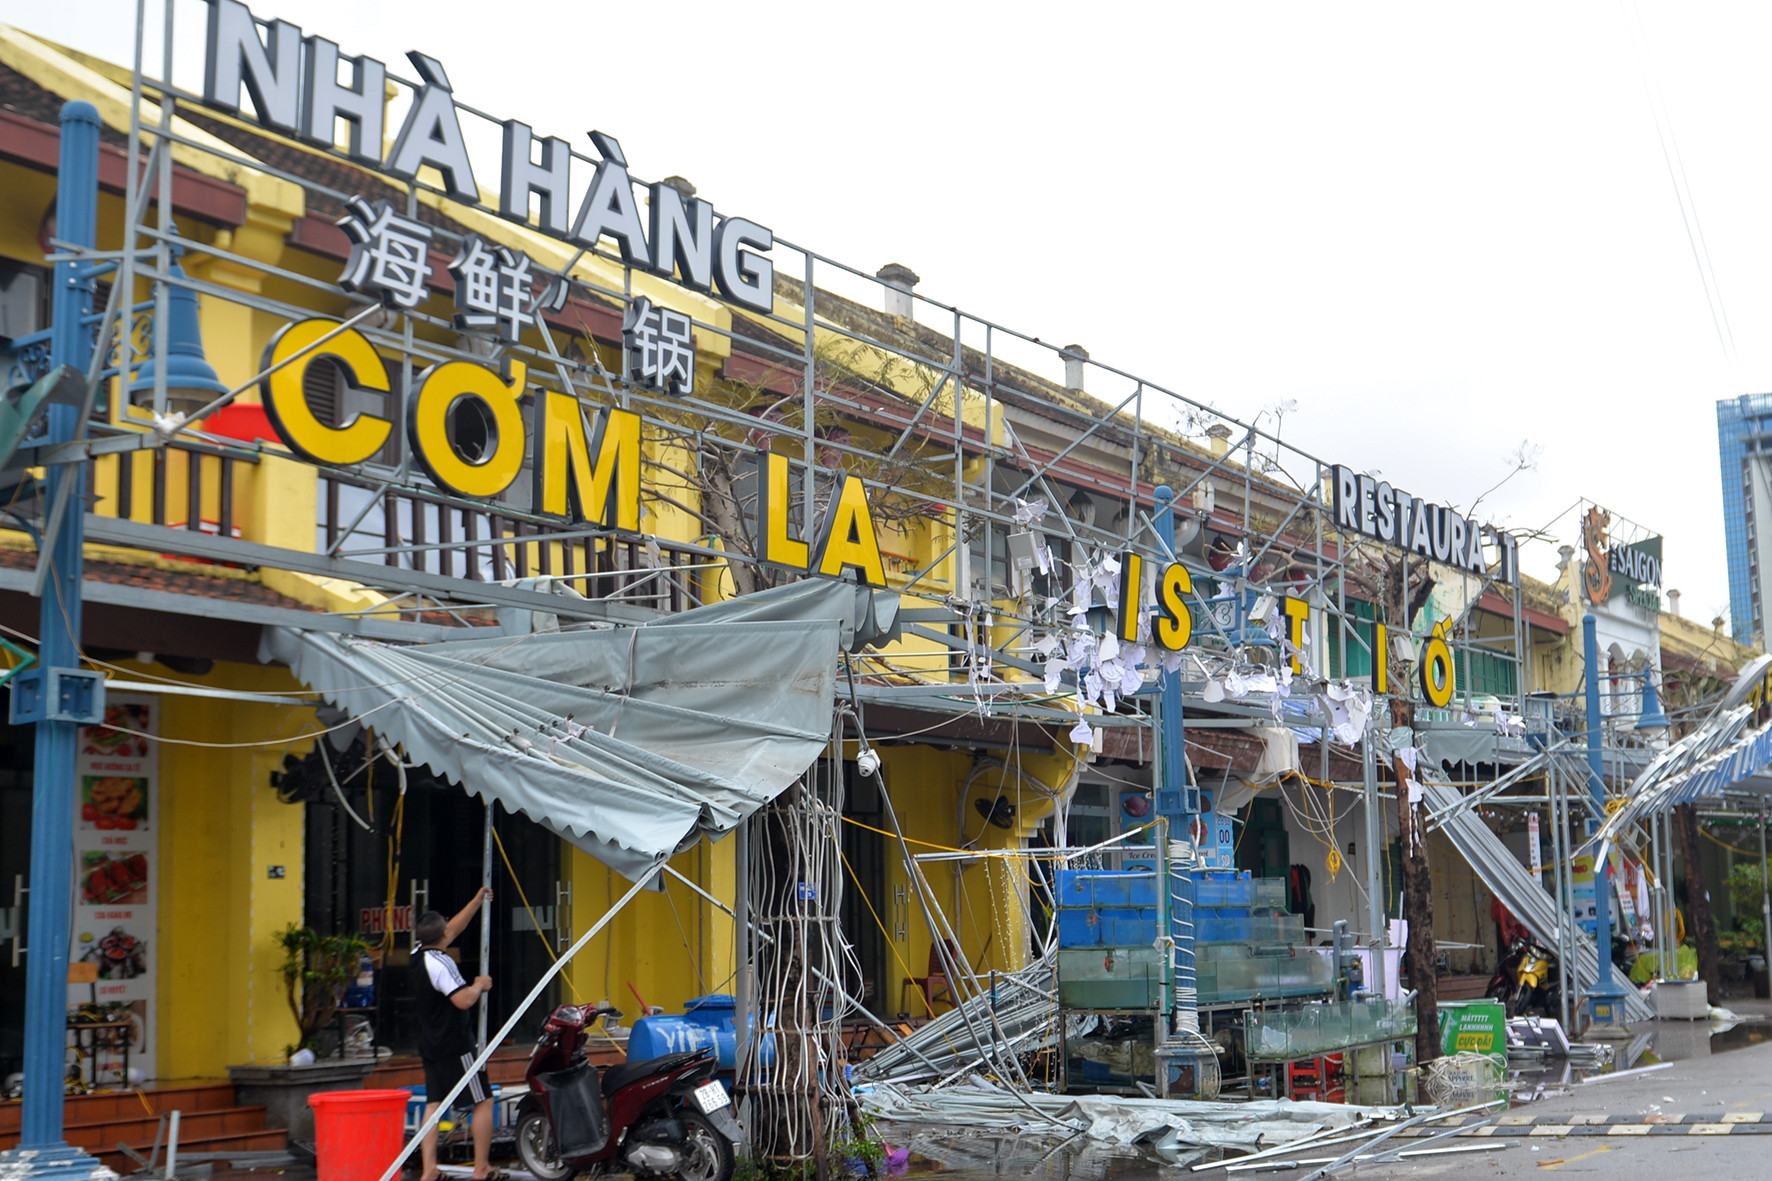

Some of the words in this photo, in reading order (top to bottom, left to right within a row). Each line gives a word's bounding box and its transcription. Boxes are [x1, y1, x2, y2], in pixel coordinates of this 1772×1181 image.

[203, 0, 480, 203] NHÀ
[500, 129, 775, 315] HÀNG
[335, 193, 696, 396] 海鲜锅
[258, 316, 642, 535] CƠM
[1331, 463, 1518, 584] RESTAURAT
